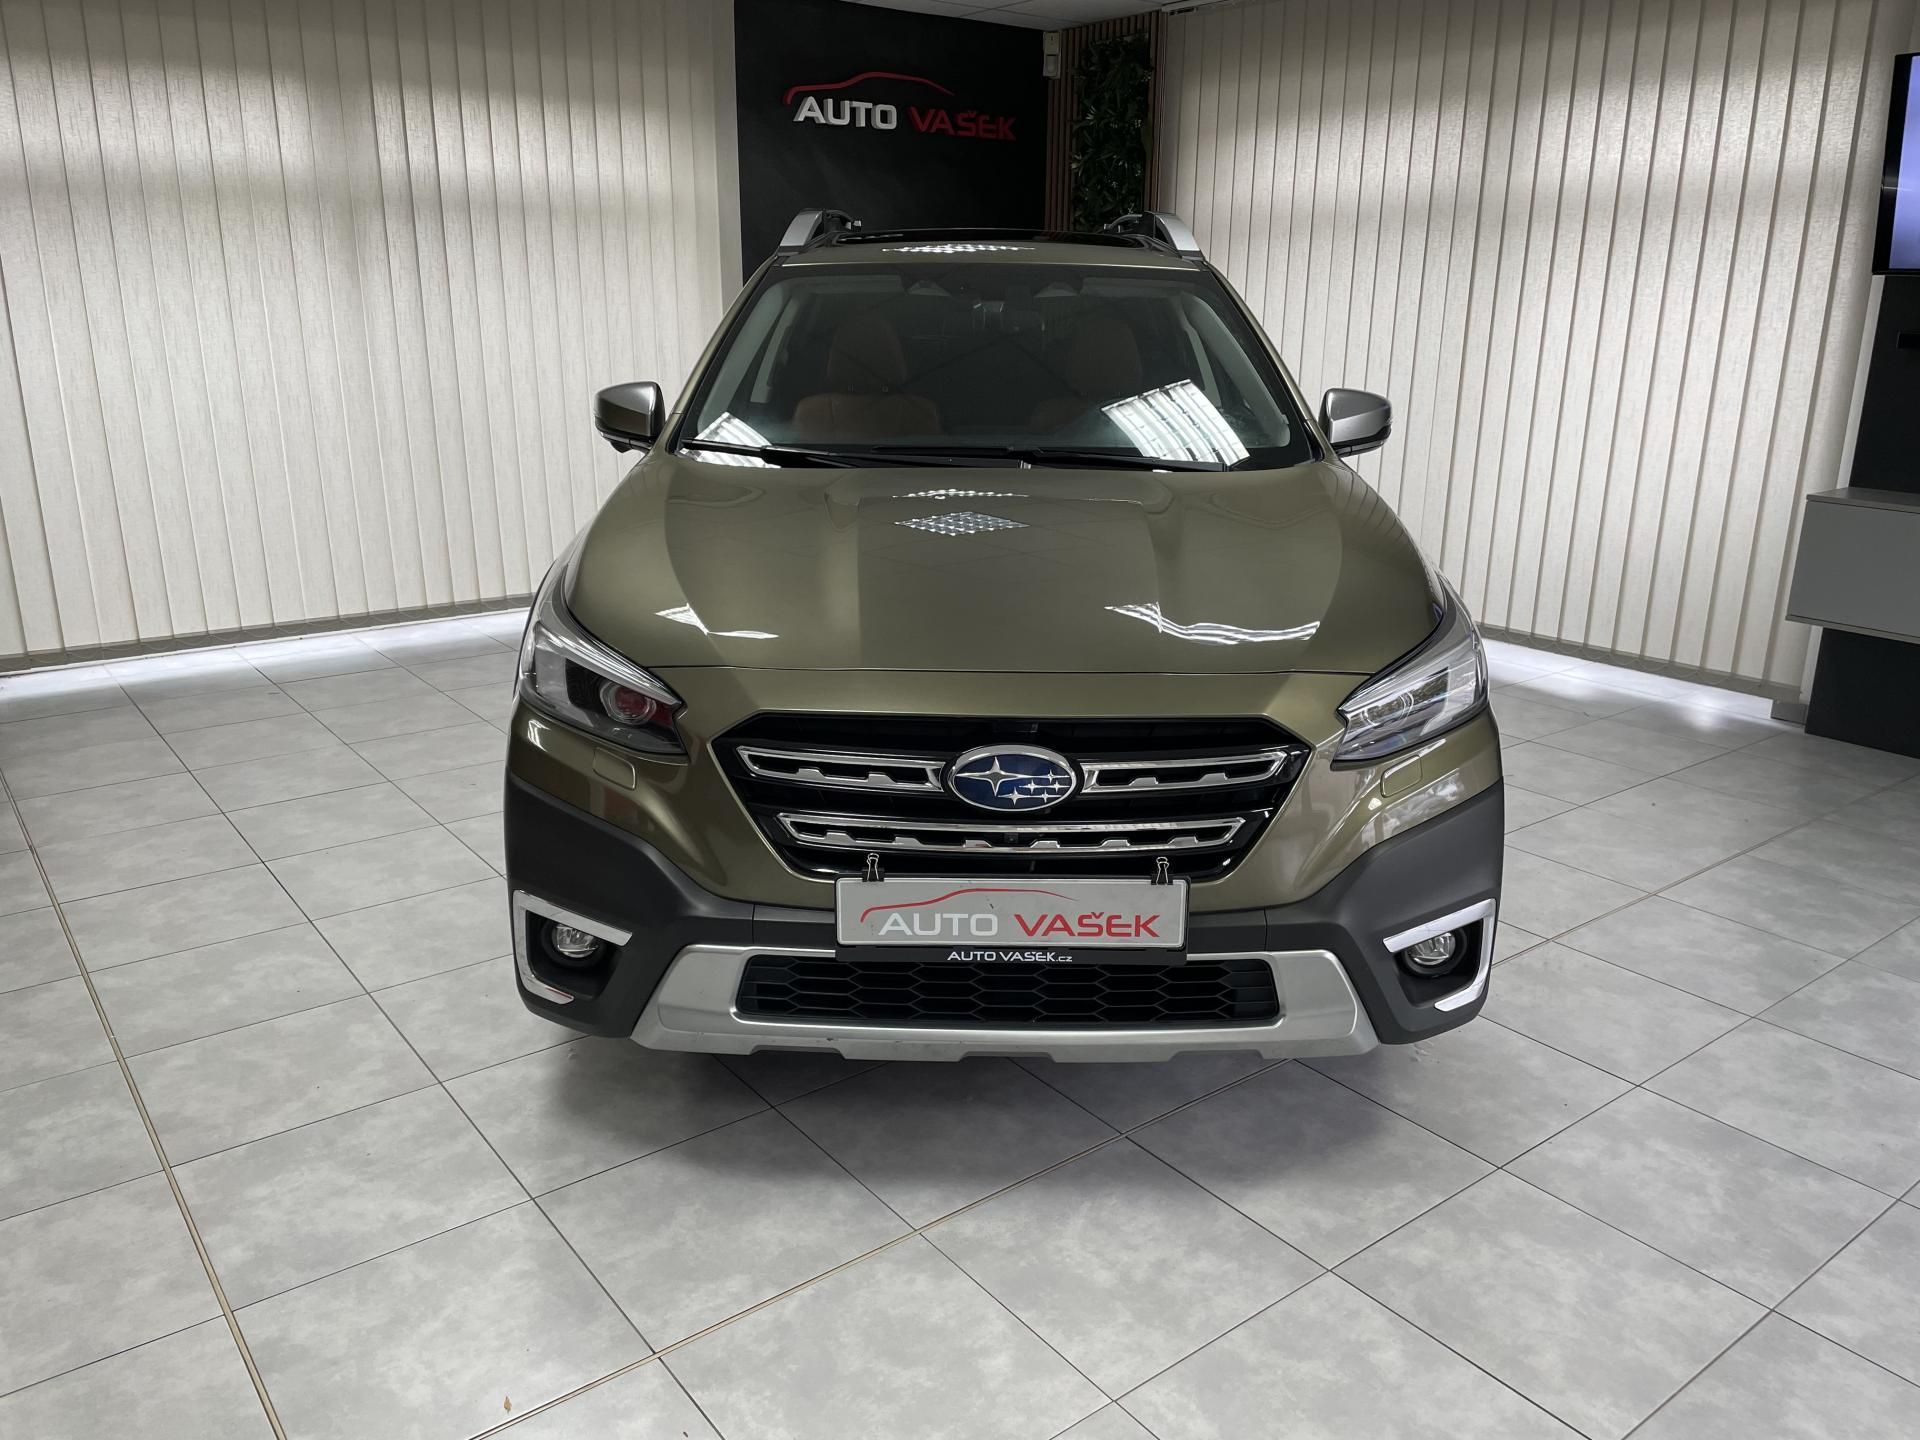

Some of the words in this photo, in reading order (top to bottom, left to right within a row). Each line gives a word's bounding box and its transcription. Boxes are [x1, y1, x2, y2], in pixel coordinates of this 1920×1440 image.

[793, 95, 897, 130] AUTO
[908, 106, 1016, 141] VAŠEK
[878, 913, 998, 937] AUTO
[1014, 911, 1160, 938] VAŠEK
[947, 951, 996, 962] AUTO
